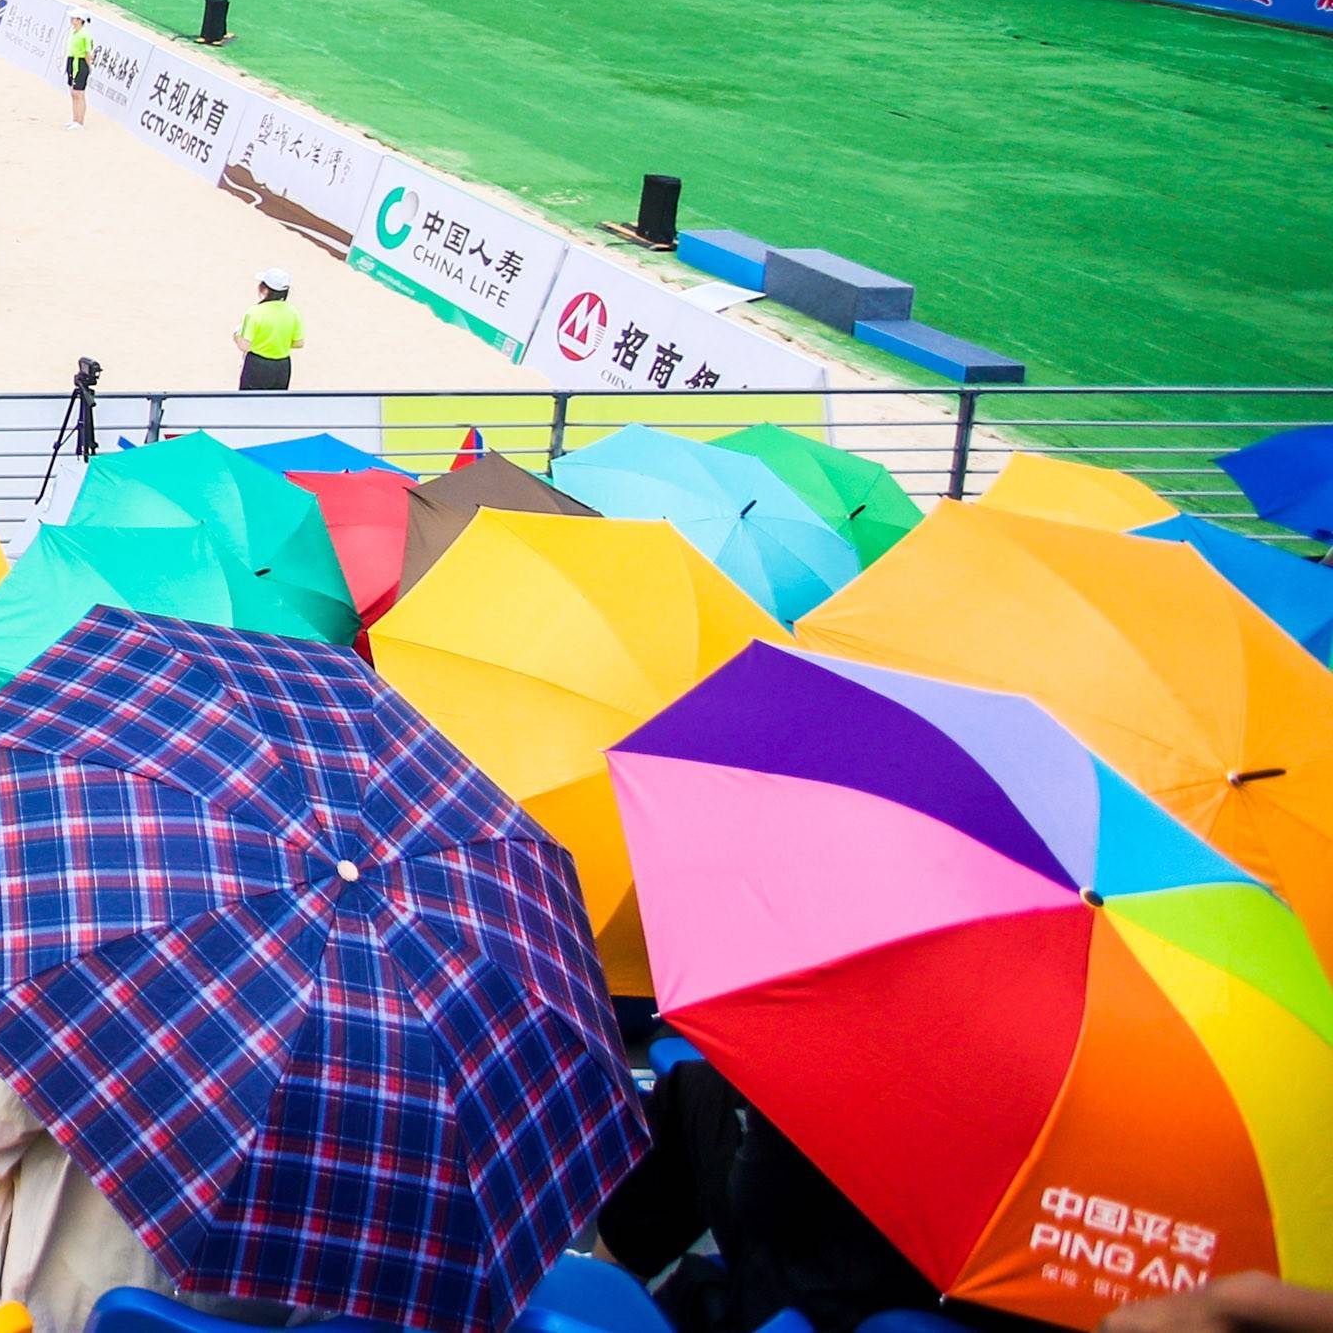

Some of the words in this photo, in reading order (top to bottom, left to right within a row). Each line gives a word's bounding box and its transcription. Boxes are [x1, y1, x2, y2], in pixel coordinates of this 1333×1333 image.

[149, 71, 229, 137] 央视体育
[141, 109, 171, 139] CCTV
[167, 124, 213, 164] SPORTS
[413, 246, 464, 283] CHINA
[469, 277, 510, 309] LIFE
[422, 210, 523, 285] 中国人寿
[1030, 1222, 1136, 1275] PING
[1041, 1186, 1217, 1262] 中国平安
